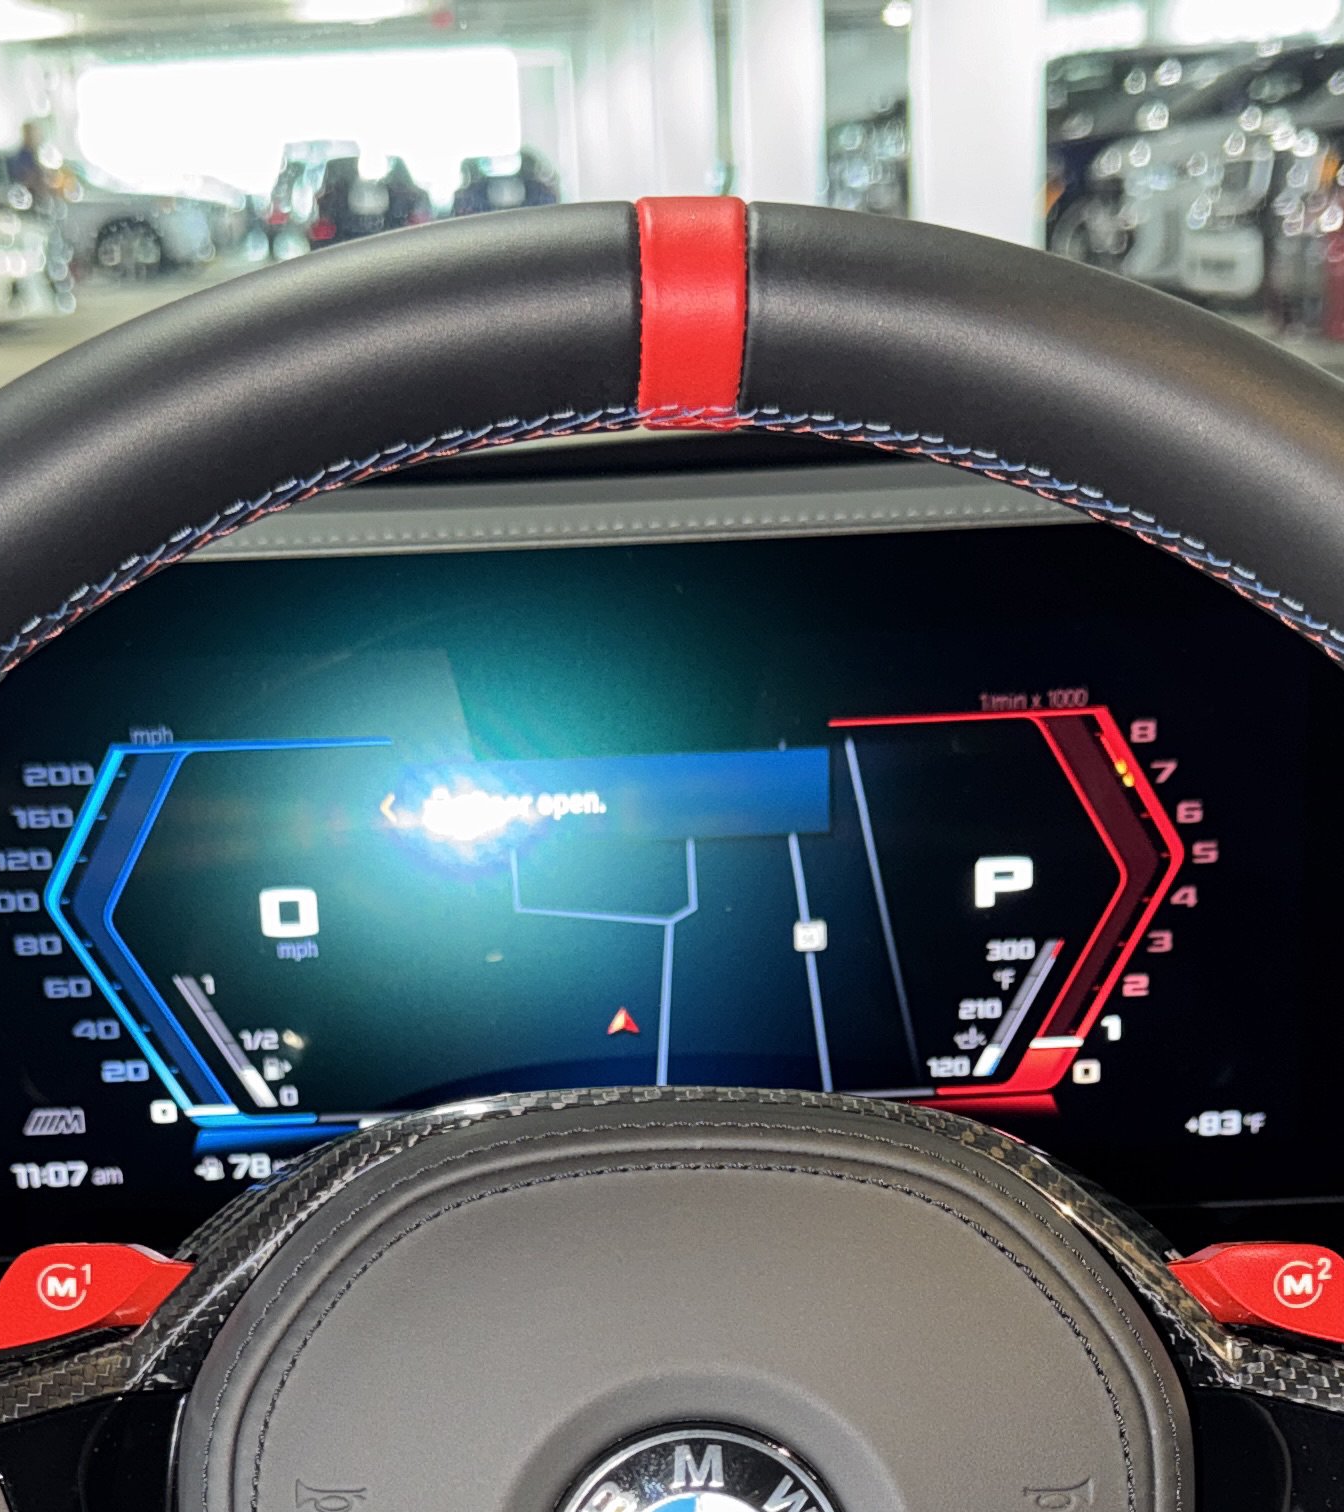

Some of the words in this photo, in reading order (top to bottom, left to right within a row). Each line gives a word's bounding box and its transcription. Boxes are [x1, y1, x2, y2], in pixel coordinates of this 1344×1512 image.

[1047, 687, 1088, 707] 1000
[128, 724, 174, 747] mph
[1130, 720, 1157, 743] 8
[23, 764, 94, 787] 200
[1150, 760, 1177, 784] 7
[537, 792, 606, 820] open.
[1176, 801, 1204, 825] 6
[12, 808, 74, 829] 160
[1192, 841, 1219, 864] 5
[974, 856, 1034, 908] P
[1170, 885, 1198, 908] 4
[259, 888, 319, 937] 0
[14, 935, 62, 957] 80
[277, 939, 319, 961] mph
[985, 938, 1035, 961] 300
[1147, 930, 1173, 954] 3
[43, 977, 91, 999] 60
[200, 974, 215, 995] 1
[1122, 974, 1150, 996] 2
[958, 997, 1002, 1020] 210
[72, 1019, 120, 1040] 40
[239, 1028, 279, 1051] 1/2
[1102, 1016, 1121, 1041] 1
[101, 1061, 149, 1082] 20
[926, 1056, 971, 1078] 120
[1072, 1060, 1101, 1085] 0
[279, 1084, 298, 1106] 0
[150, 1100, 177, 1123] 0
[10, 1160, 88, 1189] 11:07
[91, 1166, 123, 1186] am
[227, 1153, 271, 1179] 78
